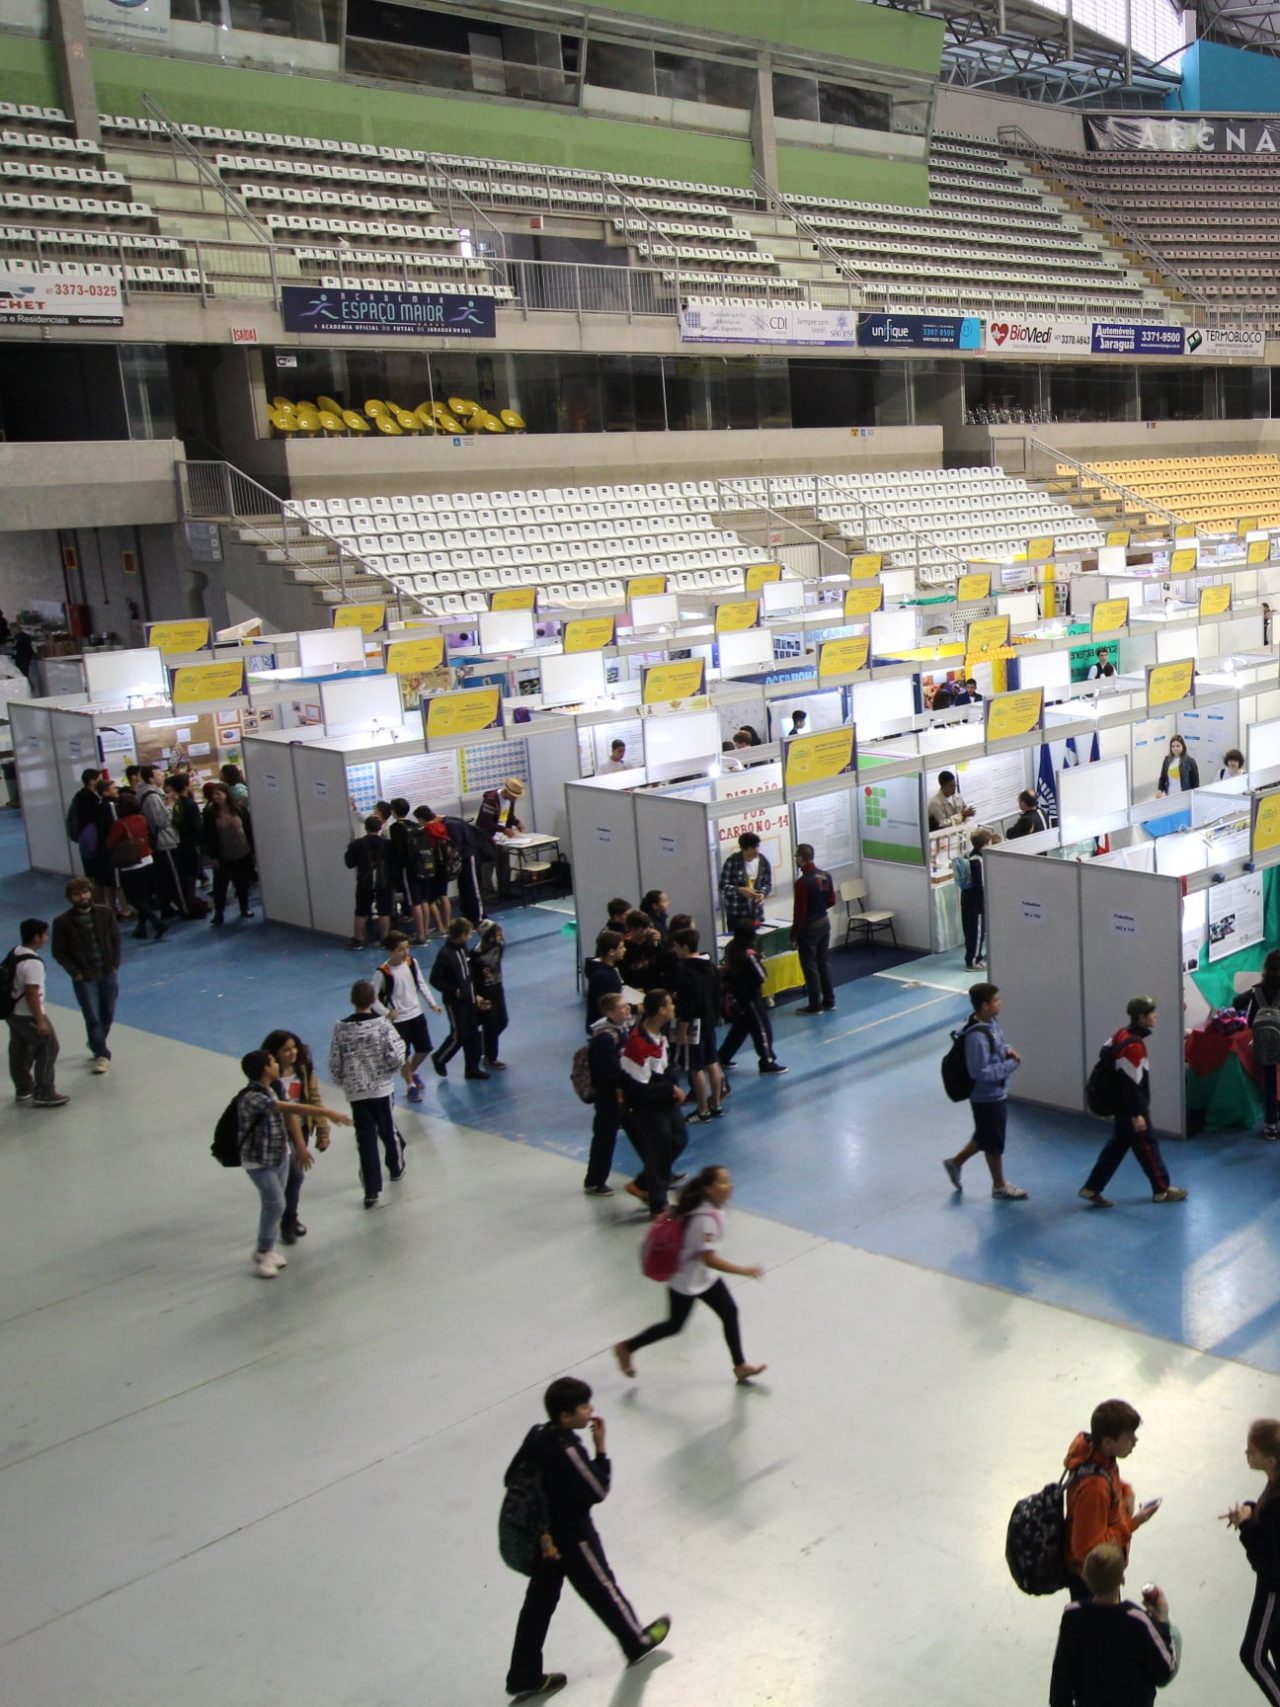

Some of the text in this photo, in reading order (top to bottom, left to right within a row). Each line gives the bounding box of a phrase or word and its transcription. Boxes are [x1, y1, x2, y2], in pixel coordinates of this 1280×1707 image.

[1138, 127, 1277, 153] ARENA
[55, 284, 118, 297] 3373-0325
[340, 291, 444, 304] ACADEMIA
[341, 301, 445, 323] ESPAÇO MAIOR
[769, 316, 788, 330] CDI
[872, 319, 909, 342] unifique
[1095, 325, 1135, 338] Automóveis
[1141, 331, 1181, 343] 3371-9500
[1205, 330, 1262, 343] TERMOBLOCO
[1100, 338, 1135, 352] Jaraguá
[719, 815, 790, 841] CARBONO-14
